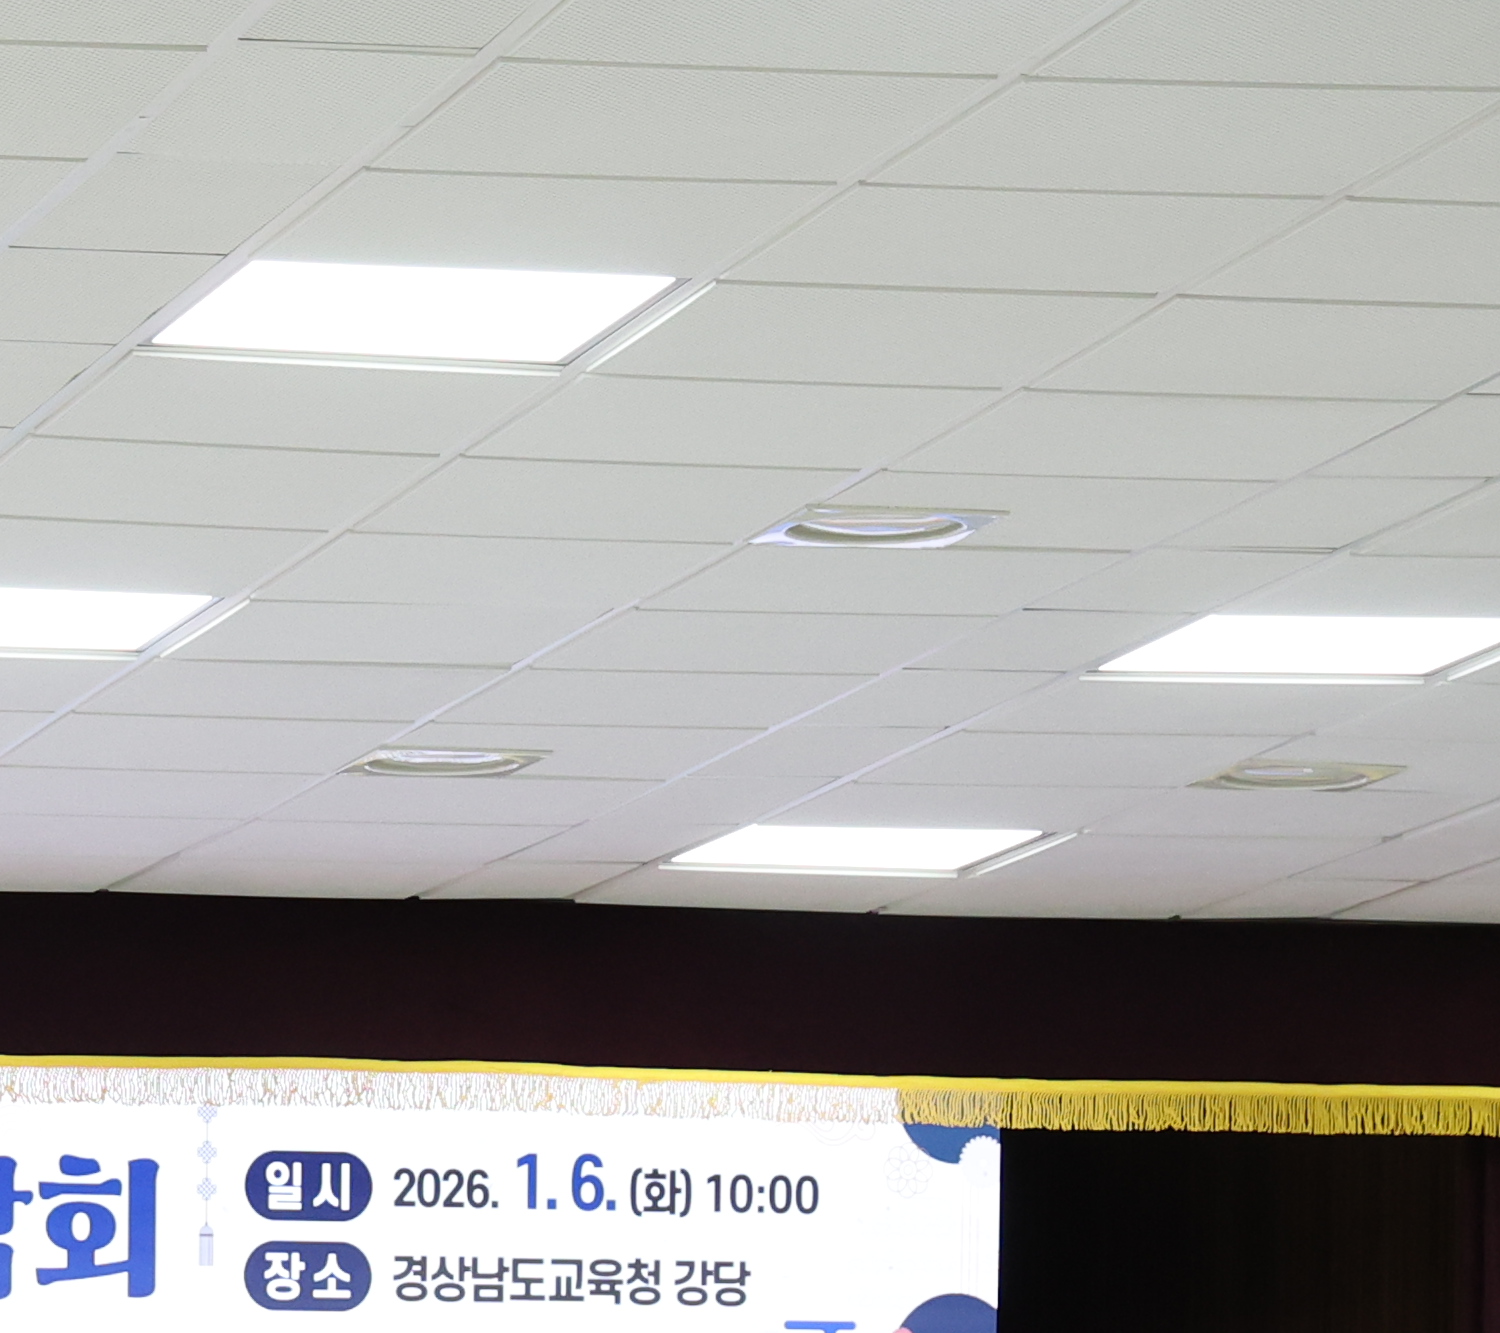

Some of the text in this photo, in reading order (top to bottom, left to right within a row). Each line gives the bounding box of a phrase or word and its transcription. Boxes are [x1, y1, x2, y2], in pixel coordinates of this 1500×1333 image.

[392, 1167, 500, 1209] 2026.
[630, 1168, 693, 1218] (화)
[707, 1174, 820, 1214] 10:00
[393, 1256, 662, 1305] 경상남도교육청
[674, 1260, 751, 1306] 강당
